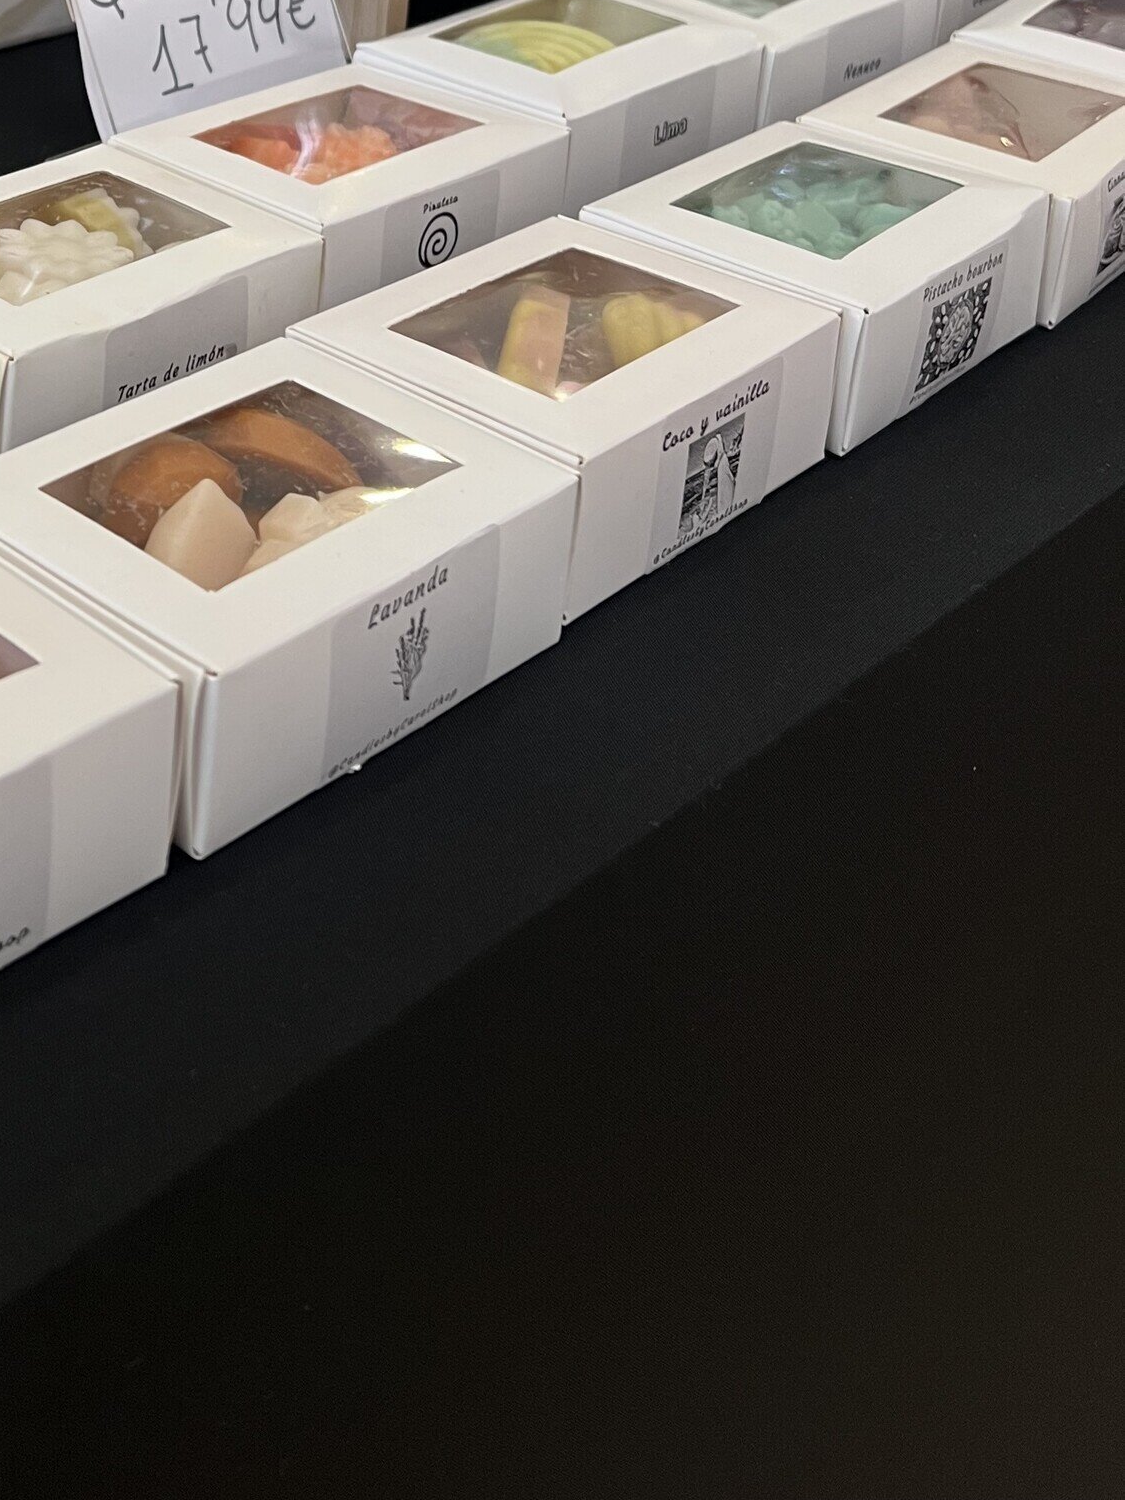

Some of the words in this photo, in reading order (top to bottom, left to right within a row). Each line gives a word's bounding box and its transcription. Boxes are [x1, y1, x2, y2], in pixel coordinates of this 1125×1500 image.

[923, 271, 964, 303] Pistacho
[117, 375, 158, 403] Tarta
[162, 362, 180, 382] de
[185, 344, 225, 373] limón
[662, 426, 695, 452] Coco
[700, 416, 709, 437] y
[715, 379, 770, 422] vainilla
[367, 564, 449, 630] Lavanda
